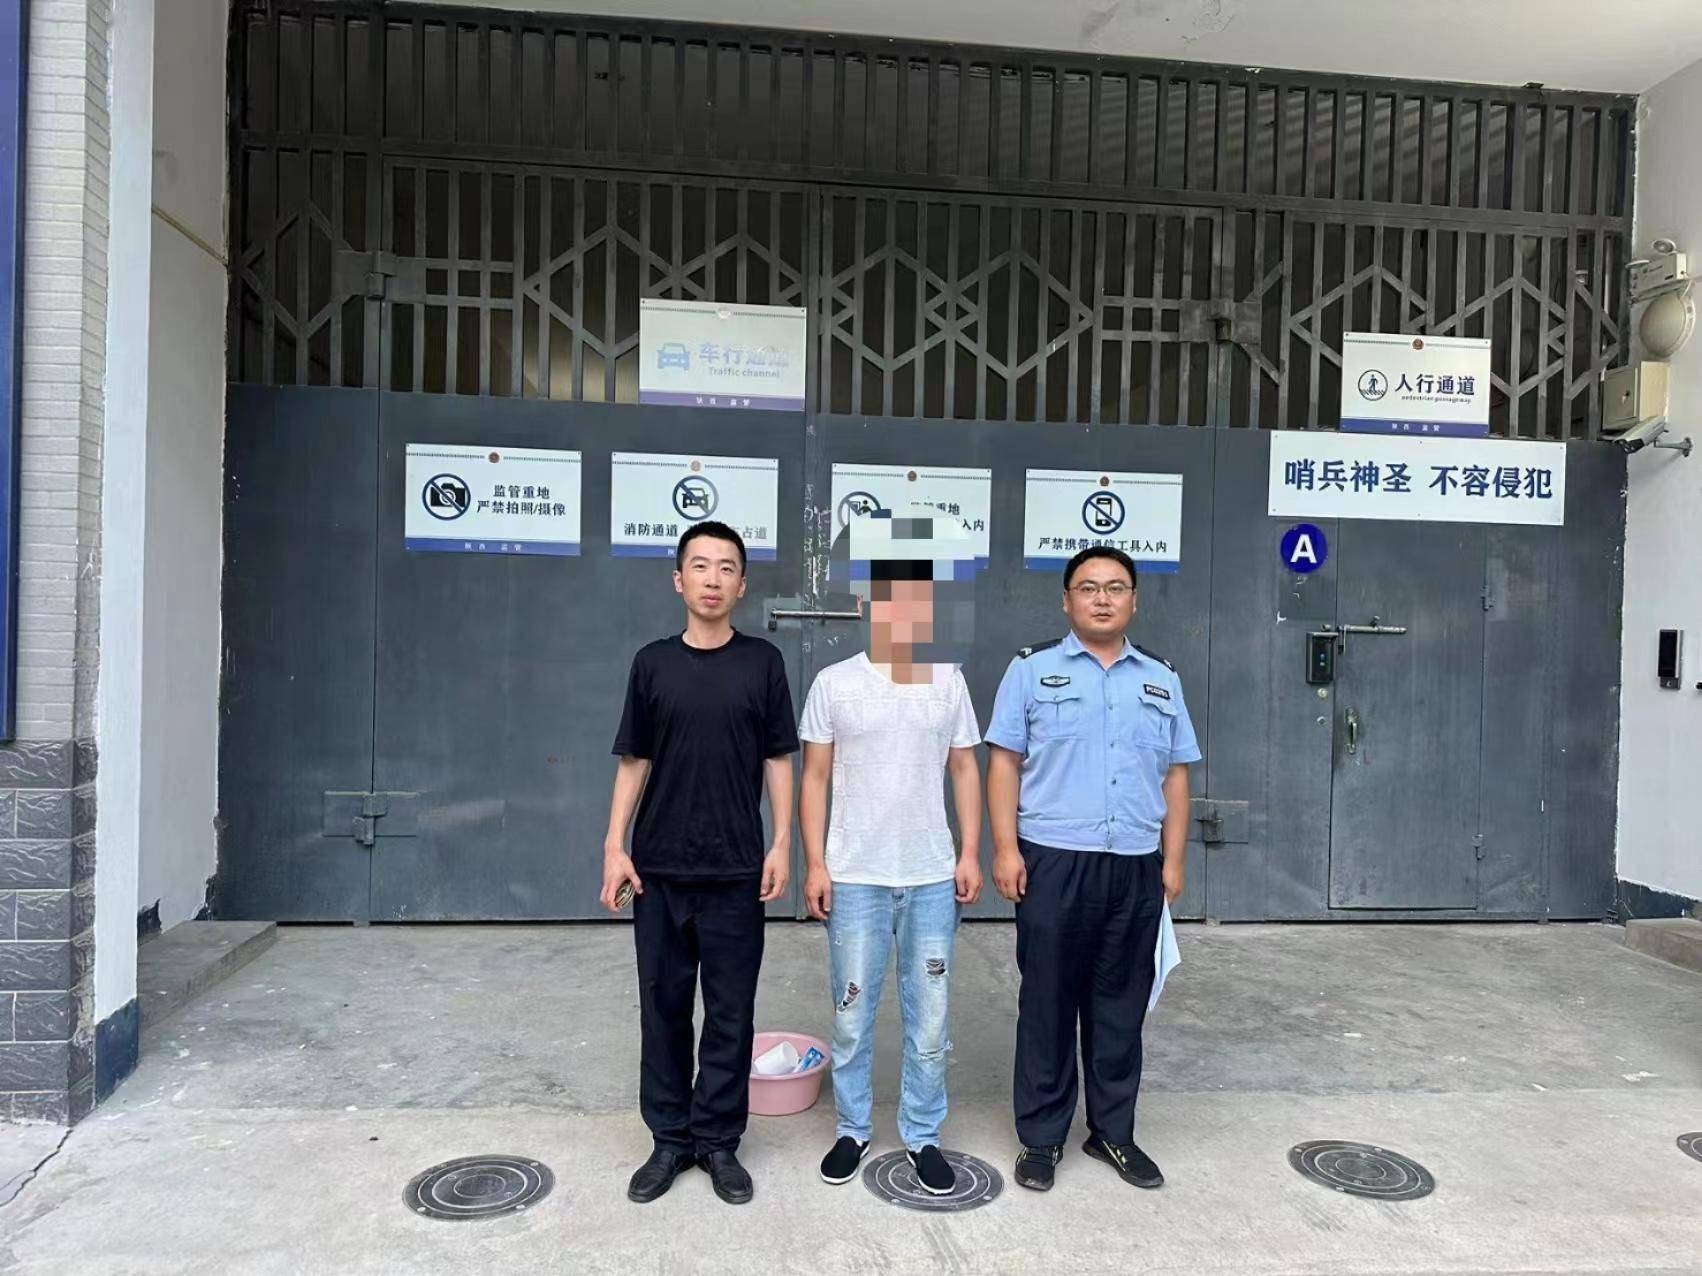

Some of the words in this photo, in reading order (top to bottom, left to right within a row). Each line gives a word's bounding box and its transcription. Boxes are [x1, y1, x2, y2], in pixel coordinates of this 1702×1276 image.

[1394, 373, 1475, 396] 人行通道
[1284, 458, 1412, 493] 哨兵神圣
[1429, 464, 1553, 499] 不容侵犯
[493, 484, 550, 500] 监管重地
[476, 500, 567, 516] 严禁拍照/摄像
[623, 522, 679, 537] 消防通道
[1290, 534, 1317, 564] A
